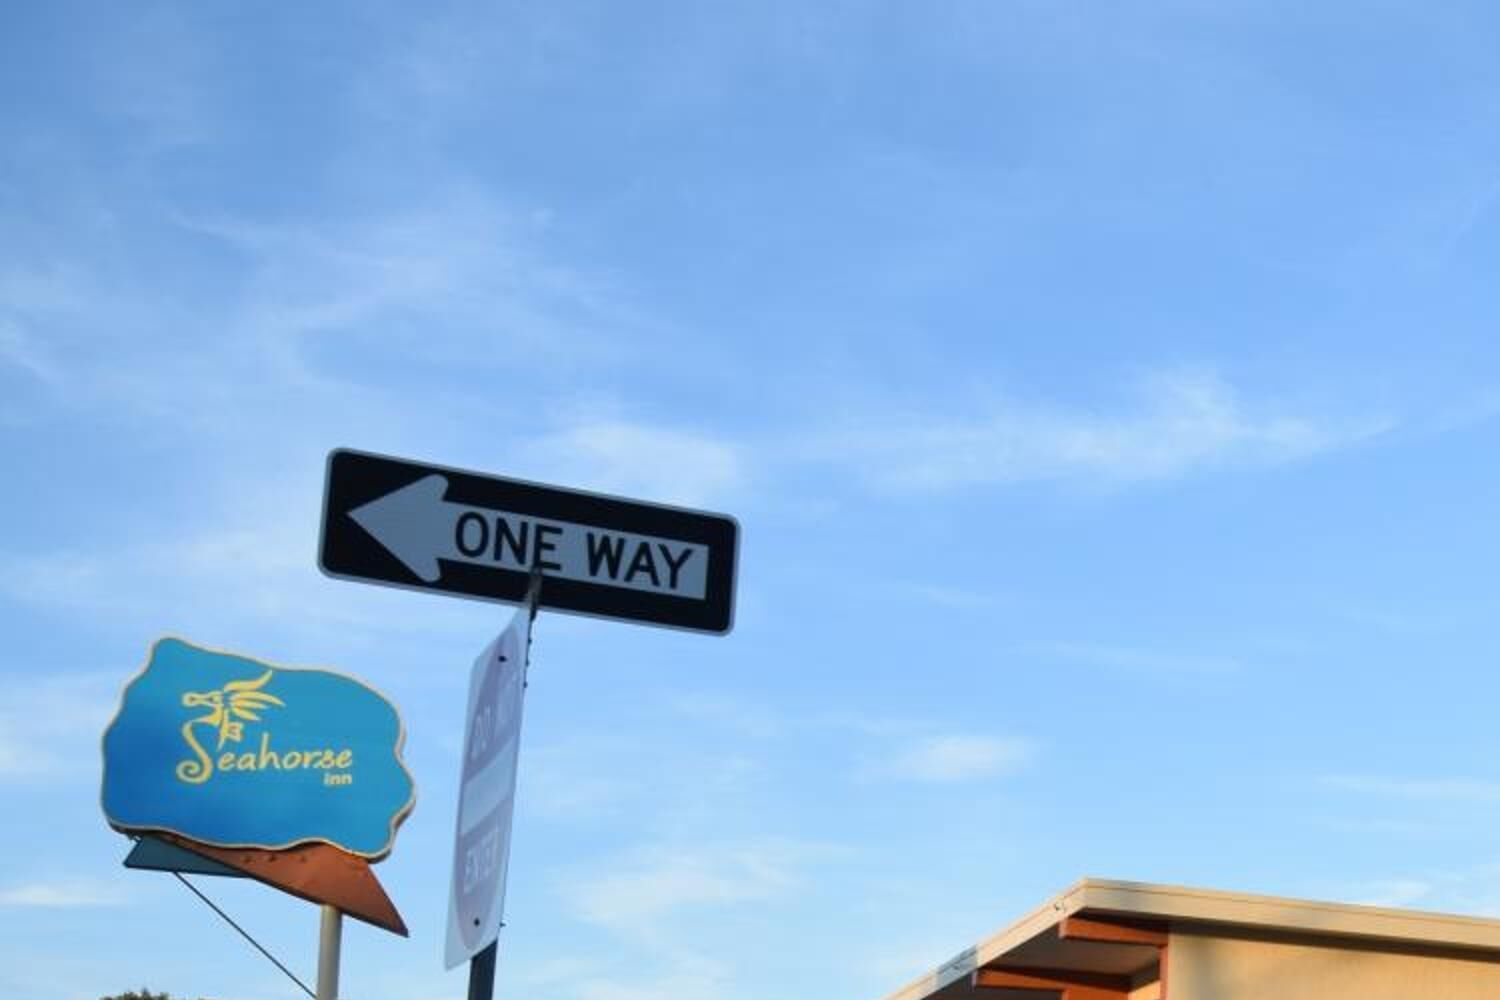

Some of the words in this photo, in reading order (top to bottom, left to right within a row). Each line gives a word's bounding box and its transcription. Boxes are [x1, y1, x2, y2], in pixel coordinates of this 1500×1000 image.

[454, 511, 564, 572] ONE
[585, 531, 694, 589] WAY
[175, 717, 353, 784] Seahorse
[323, 772, 353, 785] inn
